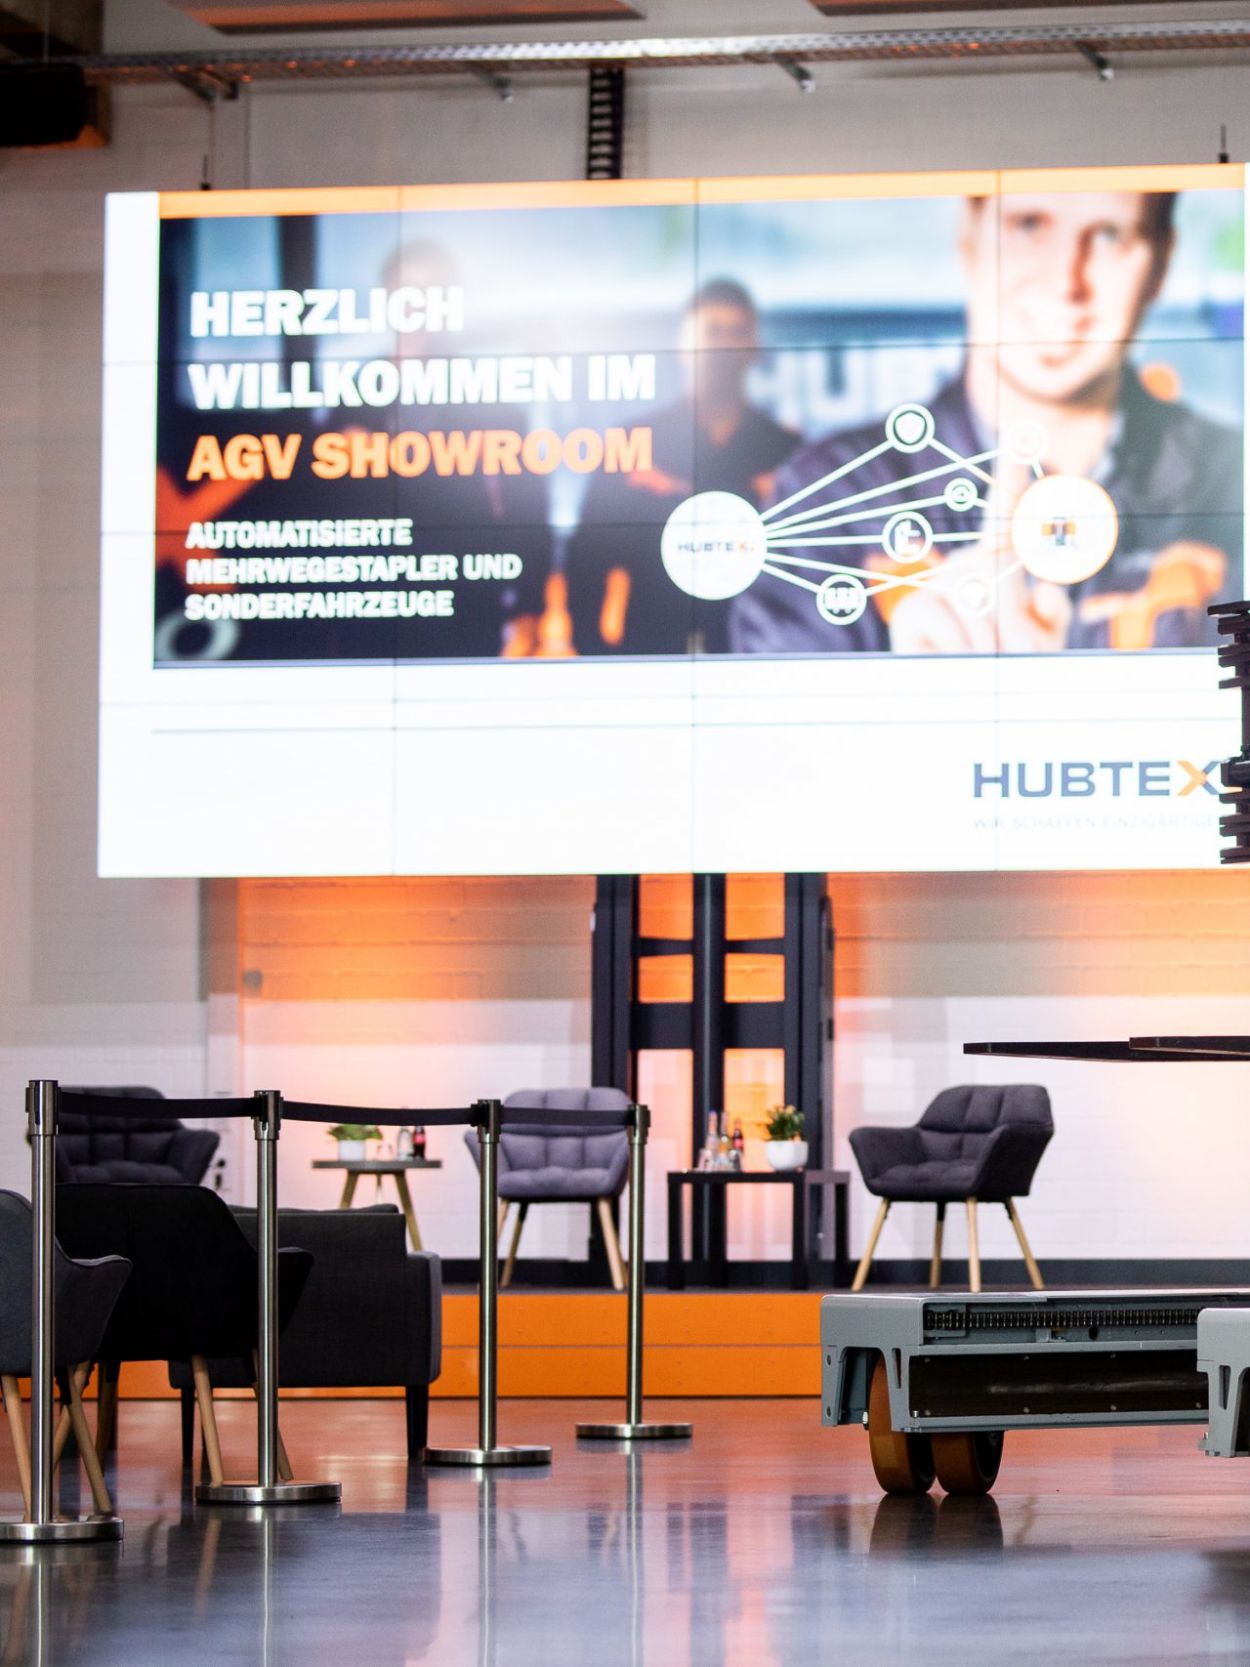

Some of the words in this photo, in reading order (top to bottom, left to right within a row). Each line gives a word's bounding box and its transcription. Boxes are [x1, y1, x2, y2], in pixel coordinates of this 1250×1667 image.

[190, 287, 464, 338] HERZLICH
[187, 360, 573, 410] WILLKOMMEN
[587, 354, 656, 402] IM
[186, 434, 301, 482] AGV
[311, 428, 653, 479] SHOWROOM
[185, 519, 413, 549] AUTOMATISIERTE
[185, 556, 457, 585] MEHRWEGESTAPLER
[462, 554, 523, 581] UND
[184, 591, 454, 621] SONDERFAHRZEUGE
